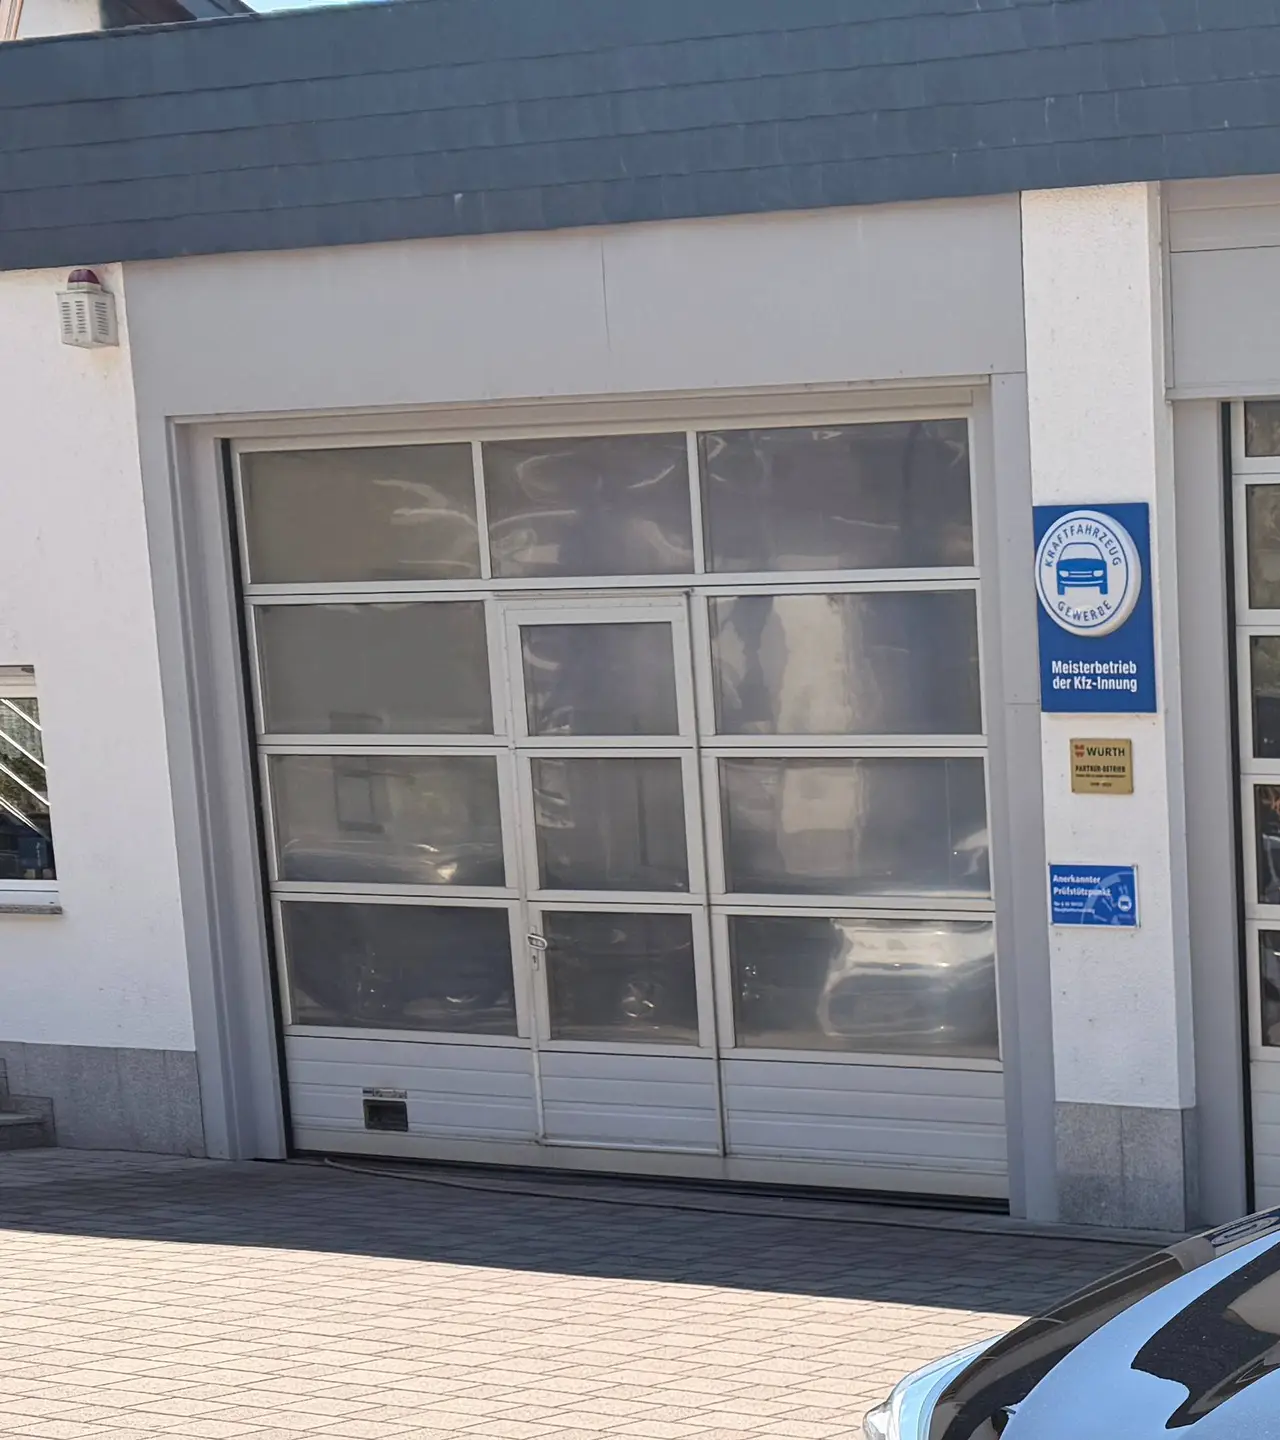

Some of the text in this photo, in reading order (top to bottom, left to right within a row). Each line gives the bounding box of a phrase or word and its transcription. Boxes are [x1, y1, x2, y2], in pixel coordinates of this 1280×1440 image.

[1044, 523, 1122, 567] KRAFTFAHRZEUG
[1057, 600, 1112, 622] GEWERBE
[1052, 660, 1137, 674] Meisterbetrieb
[1053, 676, 1138, 692] der Kfz-Innung
[1053, 874, 1101, 884] Anerkannter
